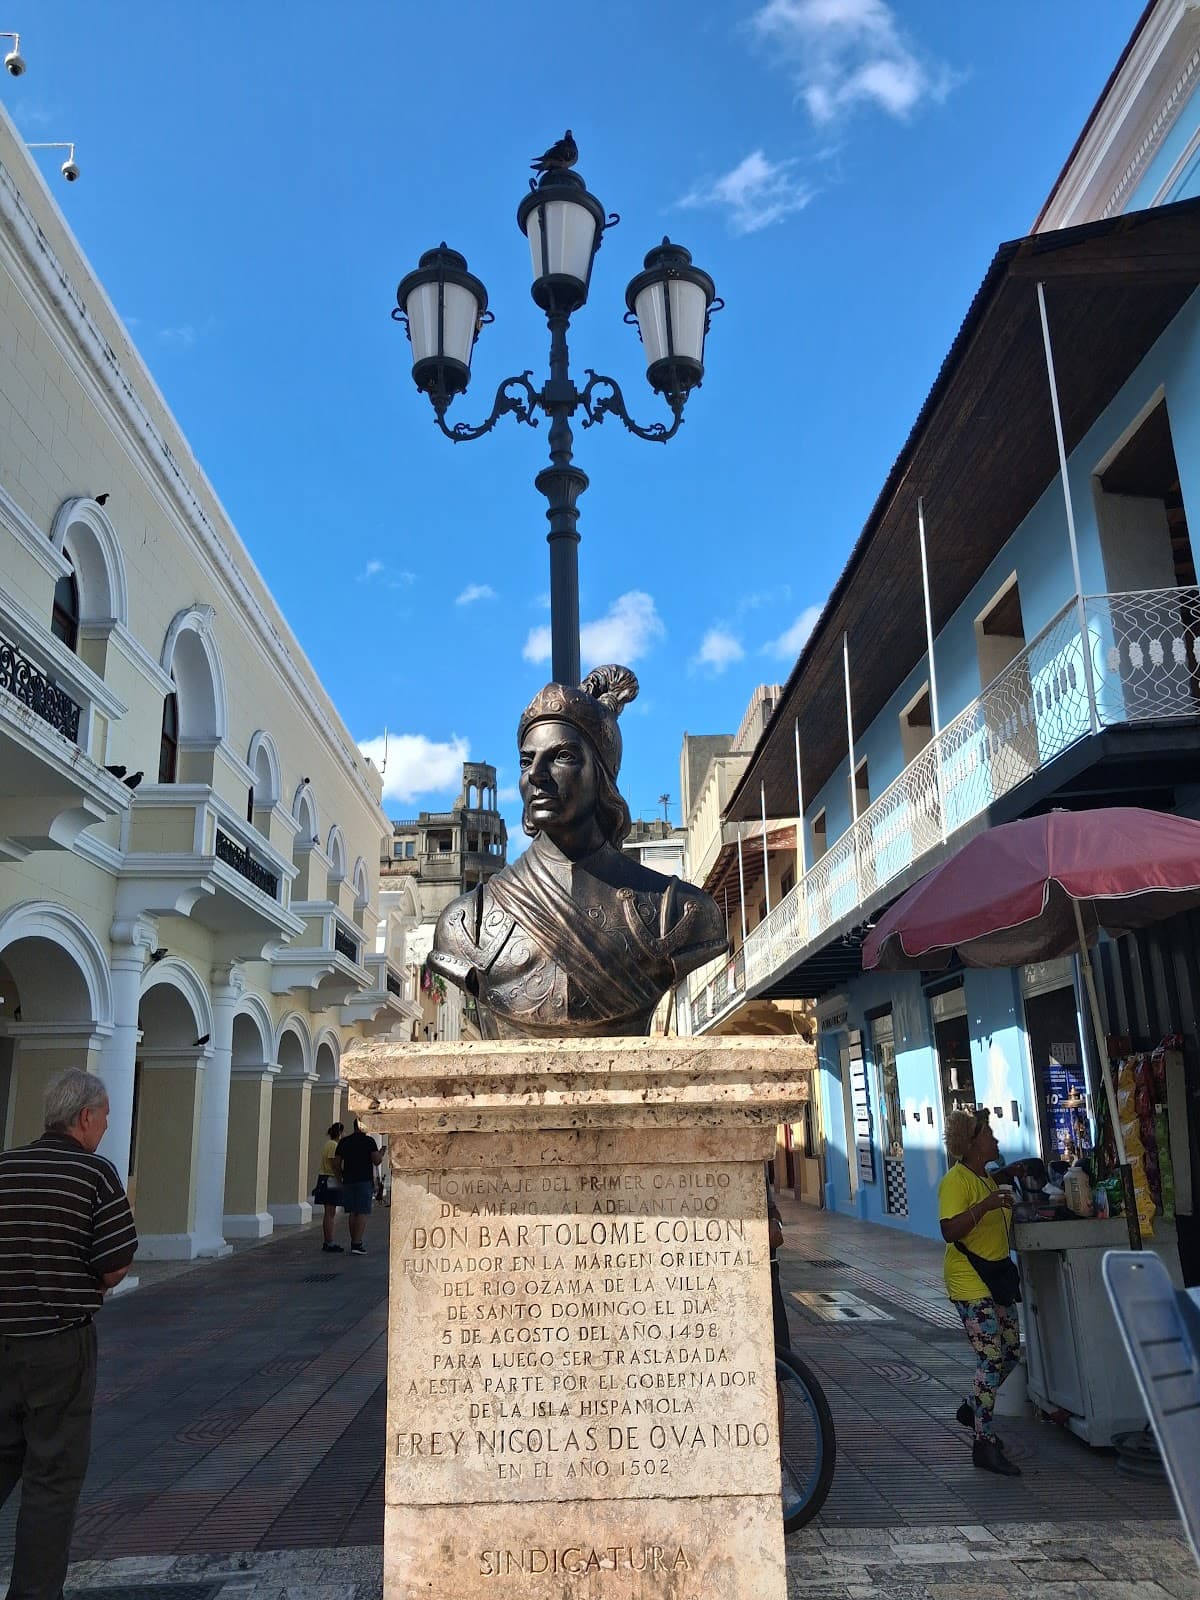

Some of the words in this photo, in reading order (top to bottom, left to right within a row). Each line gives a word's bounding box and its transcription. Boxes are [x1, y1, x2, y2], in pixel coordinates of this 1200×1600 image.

[427, 1175, 534, 1194] HOMENAJE
[542, 1177, 571, 1192] DEL
[580, 1175, 645, 1191] PRIMER
[653, 1173, 730, 1189] CABILDO
[440, 1203, 461, 1218] DE
[560, 1200, 583, 1215] AL
[592, 1197, 718, 1214] ADELANTADO
[412, 1226, 468, 1250] DON
[479, 1222, 647, 1248] BARTOLOME
[655, 1219, 745, 1243] COLON
[403, 1257, 503, 1273] FUNDADOR
[512, 1256, 536, 1271] EN
[543, 1255, 565, 1270] LA
[574, 1252, 652, 1270] MARGEN
[661, 1250, 758, 1267] ORIENTAL
[443, 1282, 475, 1297] DEL
[484, 1281, 516, 1295] RIO
[525, 1279, 594, 1295] OZAMA
[605, 1278, 625, 1293] DE
[634, 1277, 655, 1292] LA
[665, 1276, 718, 1291] VILLA
[448, 1305, 468, 1321] DE
[476, 1303, 542, 1320] SANTO
[551, 1301, 647, 1318] DOMINGO
[655, 1300, 675, 1315] EL
[442, 1329, 453, 1345] 5
[461, 1329, 482, 1344] DE
[489, 1326, 570, 1344] AGOSTO
[579, 1326, 610, 1341] DEL
[618, 1321, 662, 1340] AÑO
[670, 1323, 719, 1339] 1498
[433, 1354, 482, 1370] PARA
[492, 1351, 554, 1368] LUEGO
[563, 1350, 592, 1366] SER
[603, 1348, 729, 1366] TRASLADADA
[408, 1380, 419, 1396] A
[429, 1378, 474, 1395] ESTA
[484, 1376, 544, 1393] PARTE
[553, 1375, 588, 1391] POR
[599, 1374, 618, 1390] EL
[627, 1371, 757, 1389] GOBERNADOR
[470, 1403, 491, 1419] DE
[500, 1402, 522, 1418] LA
[532, 1401, 570, 1417] ISLA
[580, 1398, 695, 1417] HISPANIOLA
[396, 1431, 465, 1456] FREY
[476, 1427, 598, 1455] NICOLAS
[608, 1426, 640, 1450] DE
[650, 1422, 770, 1450] OVANDO
[498, 1463, 522, 1479] EN
[534, 1461, 553, 1478] EL
[567, 1457, 609, 1477] AÑO
[620, 1459, 669, 1476] 1502
[479, 1544, 692, 1576] SINDICATURA
